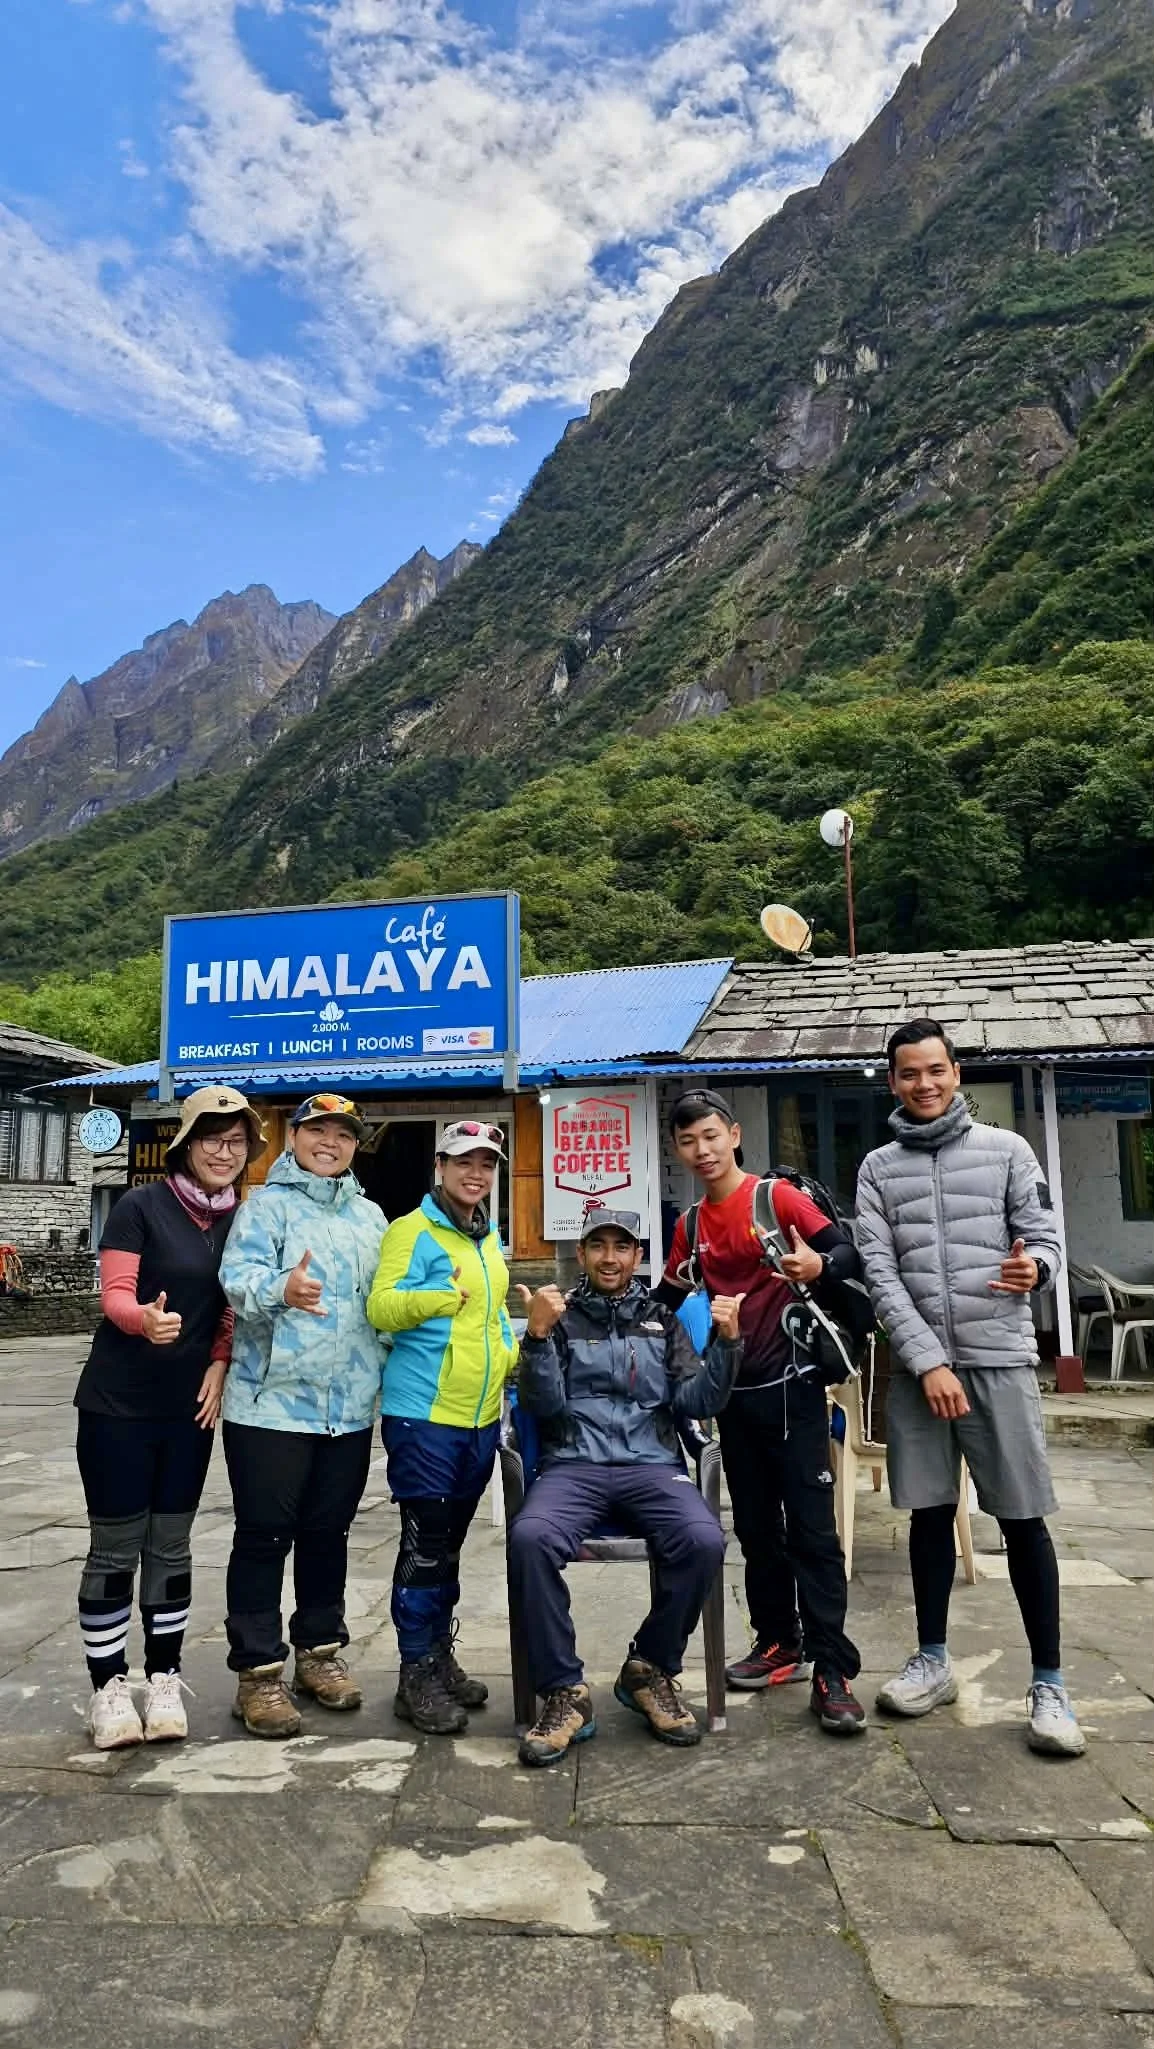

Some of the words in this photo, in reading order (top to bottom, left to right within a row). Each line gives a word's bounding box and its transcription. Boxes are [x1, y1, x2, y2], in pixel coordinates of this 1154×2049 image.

[385, 905, 447, 952] Café
[185, 945, 492, 1005] HIMALAYA
[179, 1042, 260, 1059] BREAKFAST
[282, 1038, 333, 1055] LUNCH
[357, 1035, 414, 1051] ROOMS
[441, 1035, 464, 1044] VISA
[560, 1135, 623, 1152] BEANS
[553, 1152, 631, 1174] COFFEE
